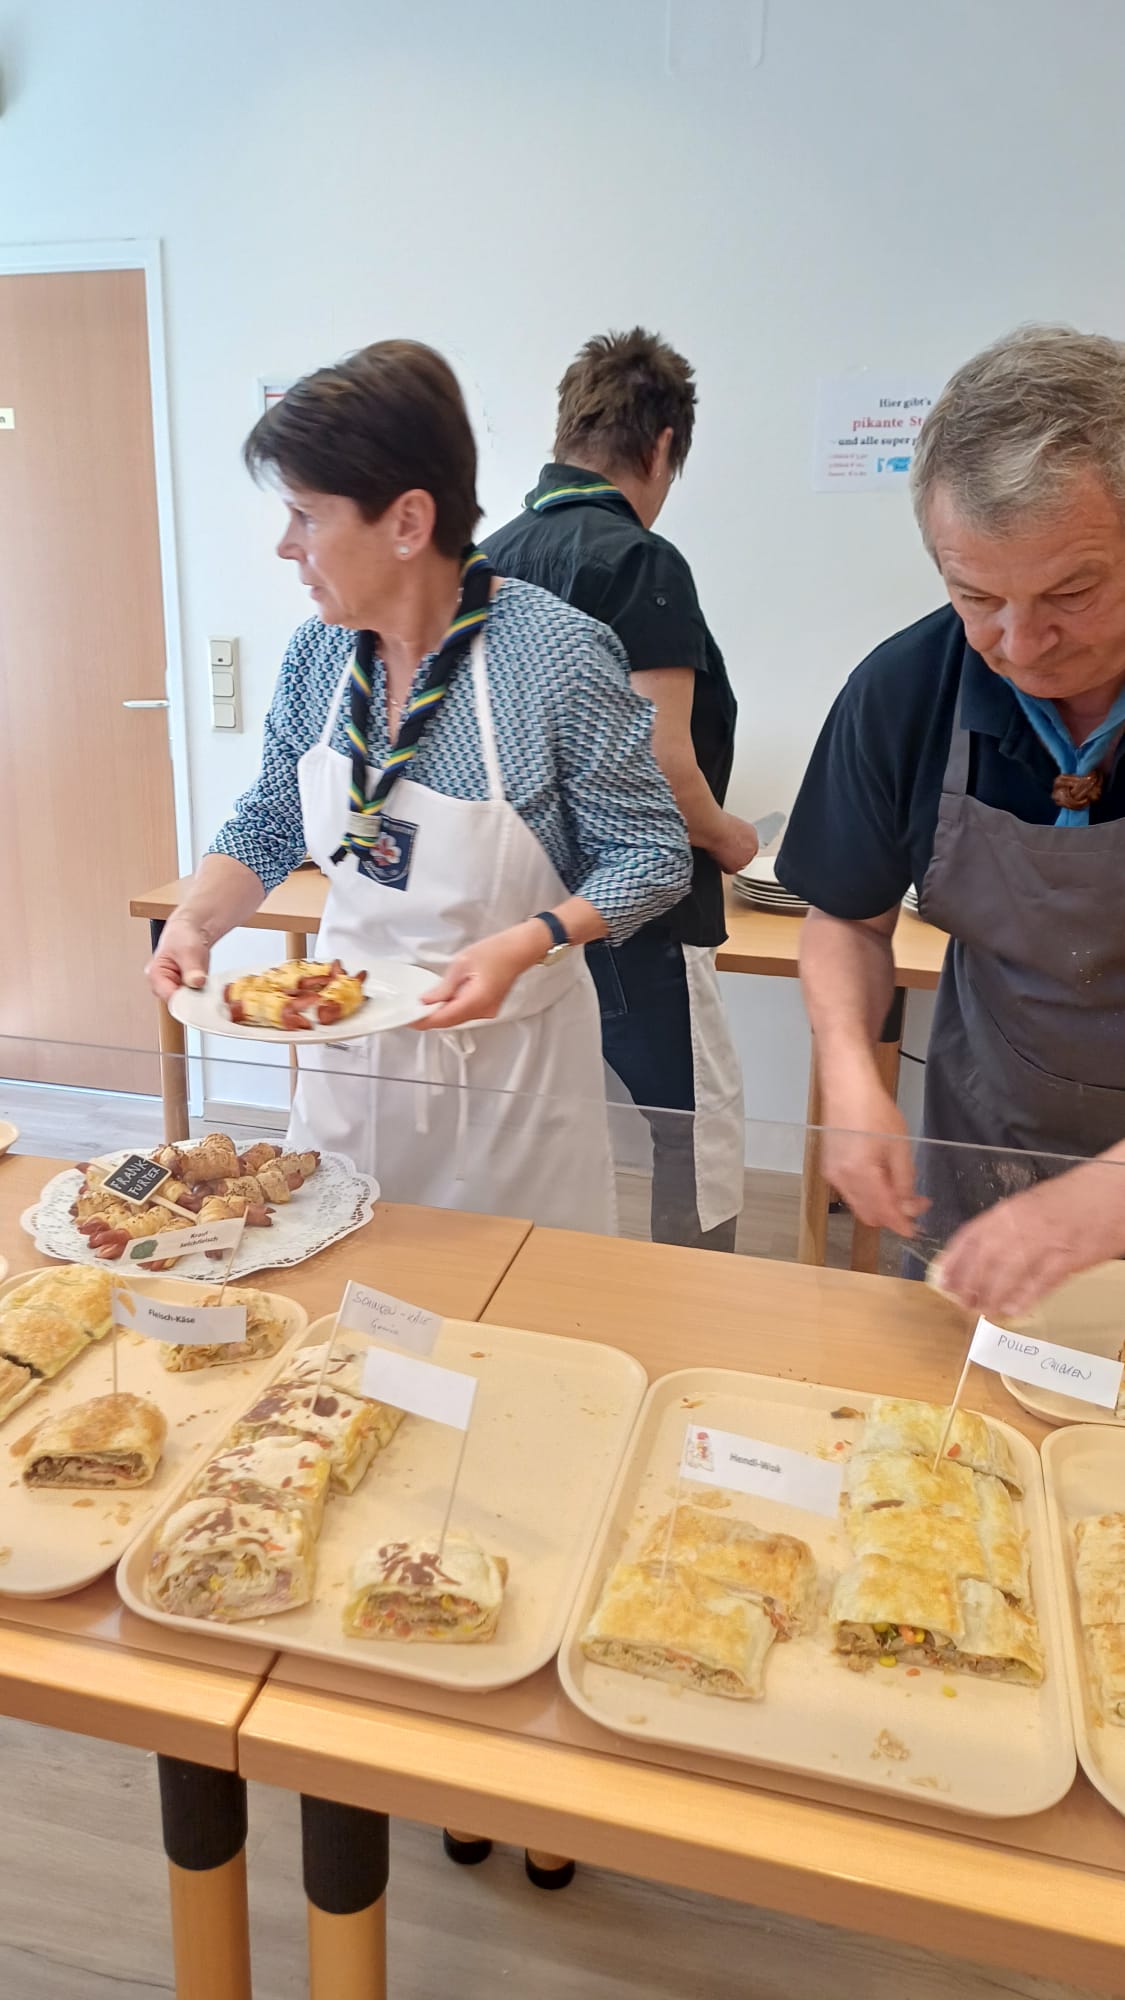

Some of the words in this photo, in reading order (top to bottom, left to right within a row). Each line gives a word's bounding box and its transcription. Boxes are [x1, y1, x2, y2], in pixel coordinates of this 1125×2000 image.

[879, 399, 902, 408] Hier
[852, 417, 904, 432] pikante
[838, 437, 858, 446] und
[860, 436, 879, 445] alle
[881, 437, 910, 447] super
[148, 1308, 196, 1324] Fleisch-Käse
[997, 1334, 1040, 1356] PULLED
